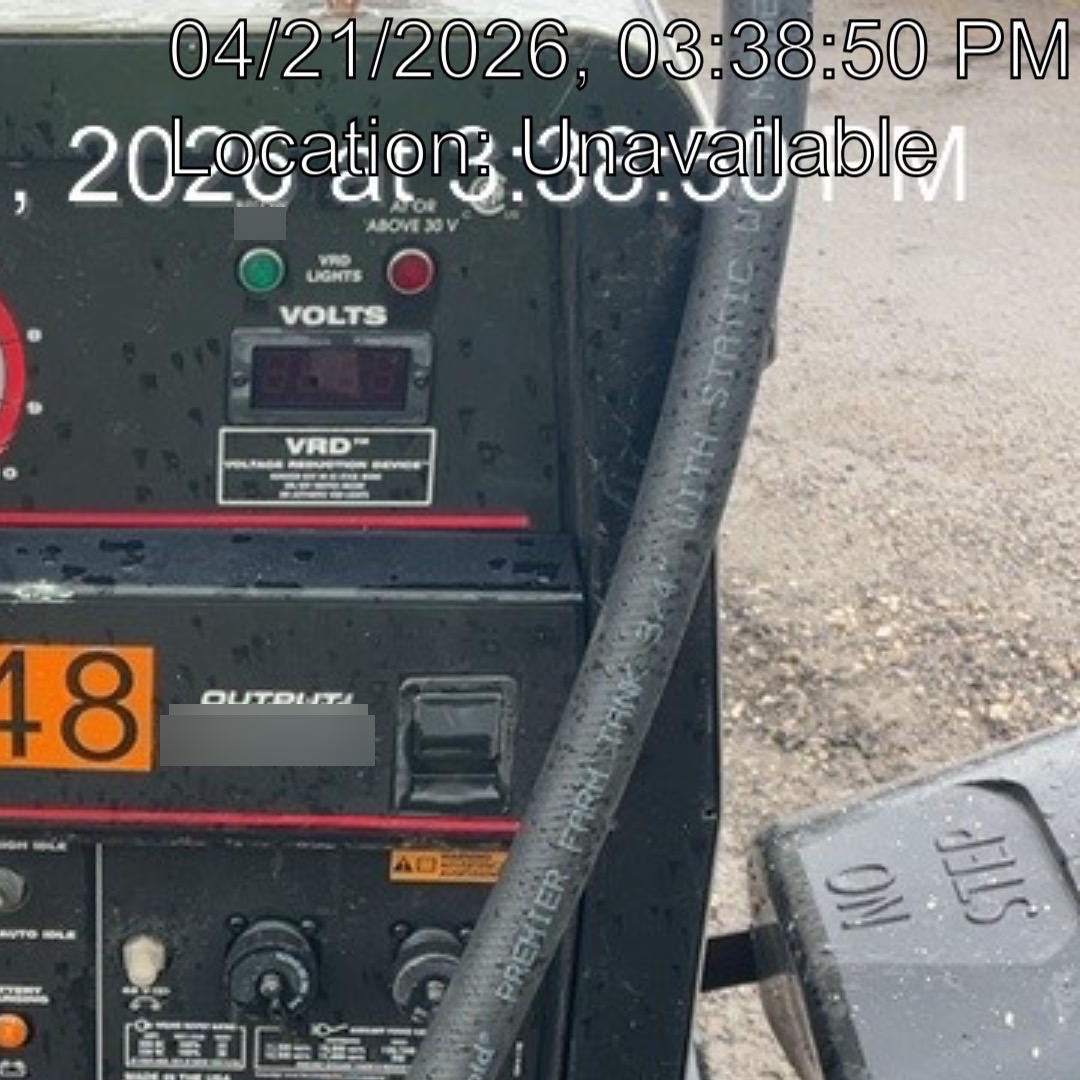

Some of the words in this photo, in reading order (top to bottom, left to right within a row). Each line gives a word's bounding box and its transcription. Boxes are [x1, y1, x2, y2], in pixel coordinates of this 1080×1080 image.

[366, 219, 419, 233] ABOVE
[423, 219, 444, 233] 30
[447, 219, 459, 232] V
[319, 254, 352, 267] VRD
[306, 270, 363, 284] LIGHTS
[279, 305, 388, 326] VOLTS
[26, 328, 43, 343] 8
[26, 401, 43, 415] 9
[498, 866, 572, 1006] PREMIER
[559, 765, 612, 853] FARM
[598, 667, 646, 749] TANK
[673, 429, 721, 532] WITH
[701, 258, 756, 410] STATIC
[32, 841, 68, 851] IDLE
[934, 828, 1040, 925] STEP
[824, 863, 913, 932] NO
[42, 930, 77, 941] IDLE
